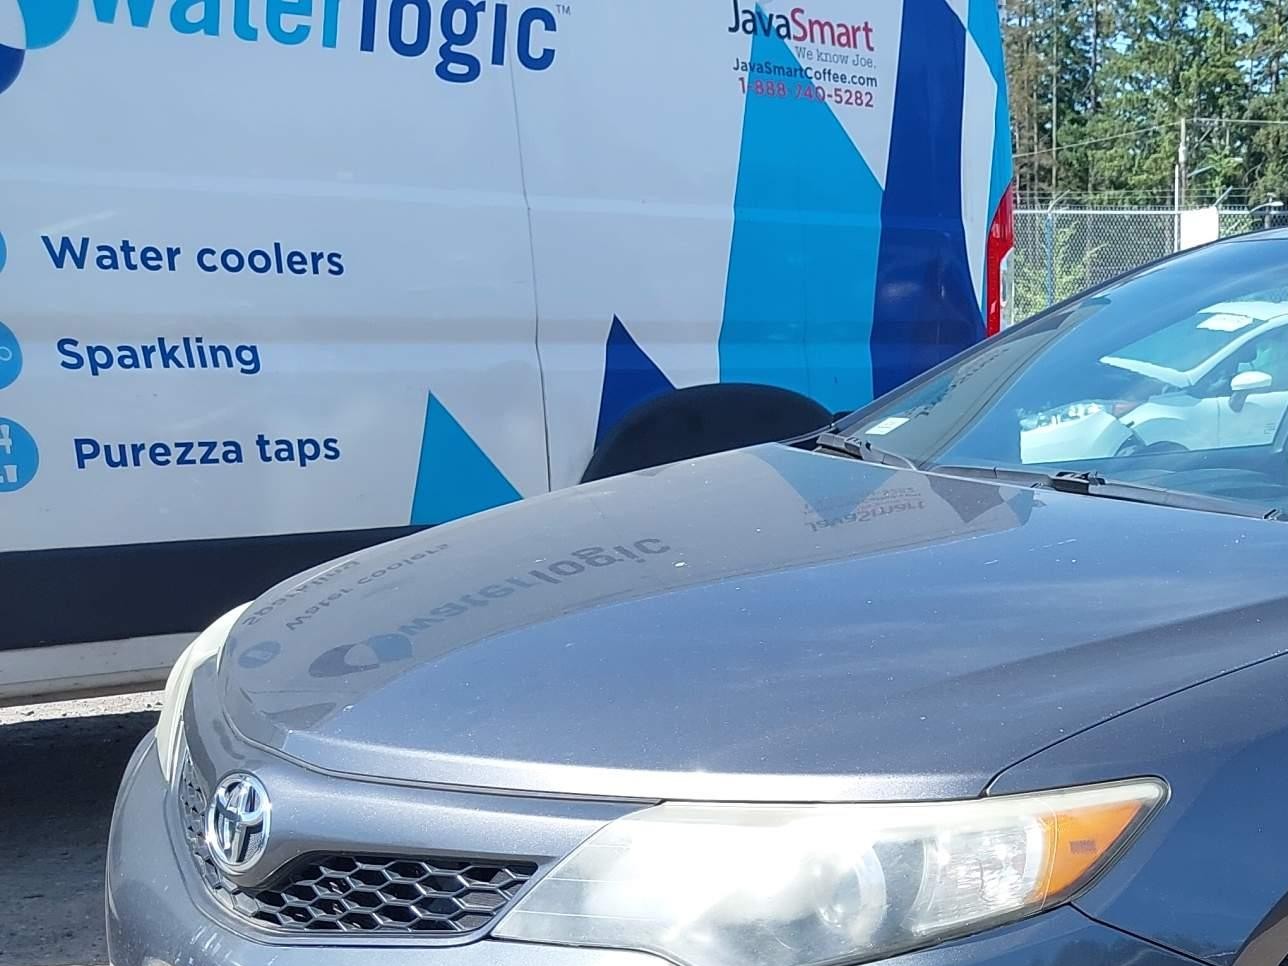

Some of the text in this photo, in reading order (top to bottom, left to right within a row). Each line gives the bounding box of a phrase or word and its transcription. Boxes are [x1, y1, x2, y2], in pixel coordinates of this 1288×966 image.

[728, 0, 874, 51] JavaSmart
[732, 58, 878, 87] JavaSmartCoffee.com
[795, 46, 877, 69] We know Joe.
[41, 236, 345, 276] Water coolers
[57, 337, 261, 376] Sparkling
[74, 434, 341, 470] Purezza taps
